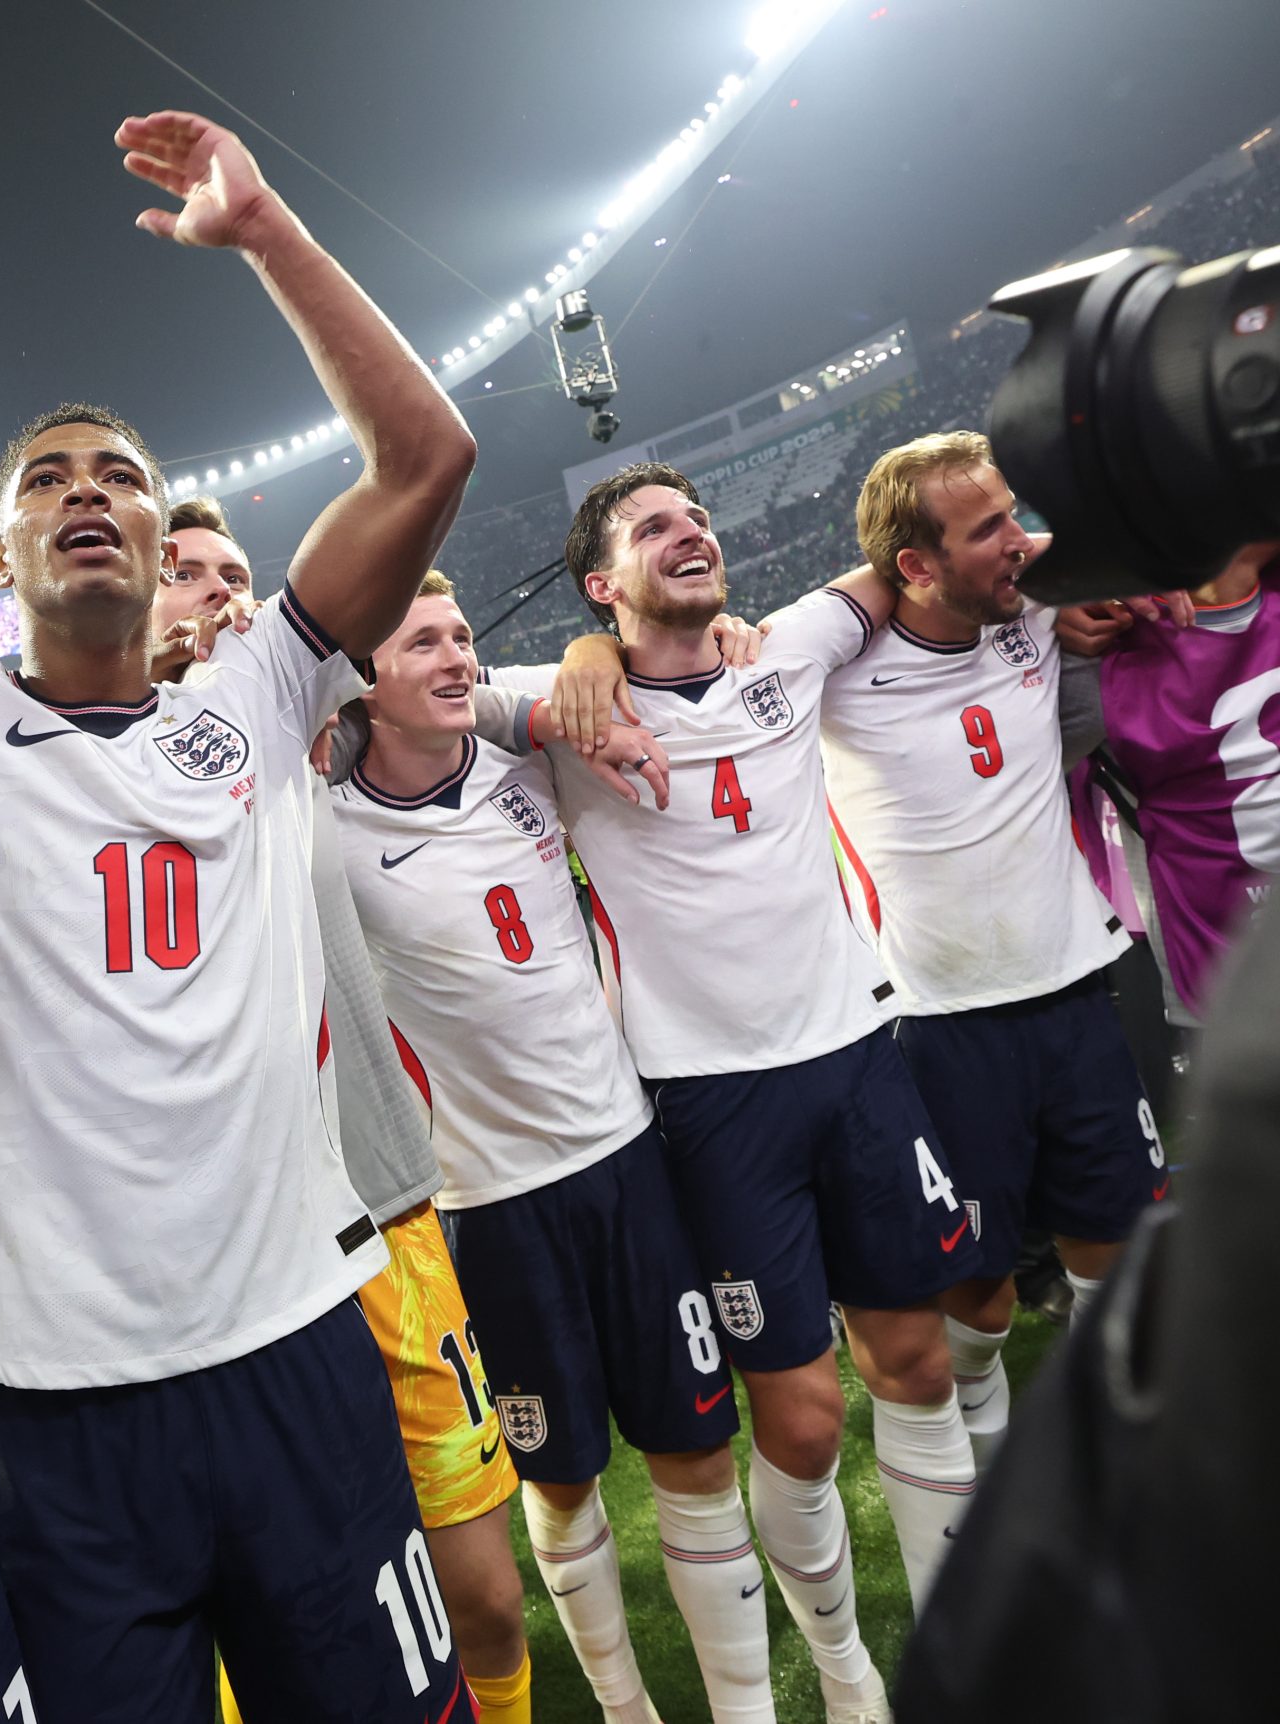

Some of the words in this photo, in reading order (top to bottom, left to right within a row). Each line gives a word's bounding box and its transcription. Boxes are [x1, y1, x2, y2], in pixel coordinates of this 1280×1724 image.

[748, 446, 780, 468] CUP
[780, 421, 836, 455] 2026
[960, 704, 1004, 778] 9
[711, 755, 752, 833] 4
[94, 841, 201, 973] 10
[484, 884, 534, 964] 8
[1137, 1098, 1165, 1169] 9
[914, 1136, 959, 1213] 4
[678, 1289, 721, 1375] 8
[375, 1528, 452, 1697] 10
